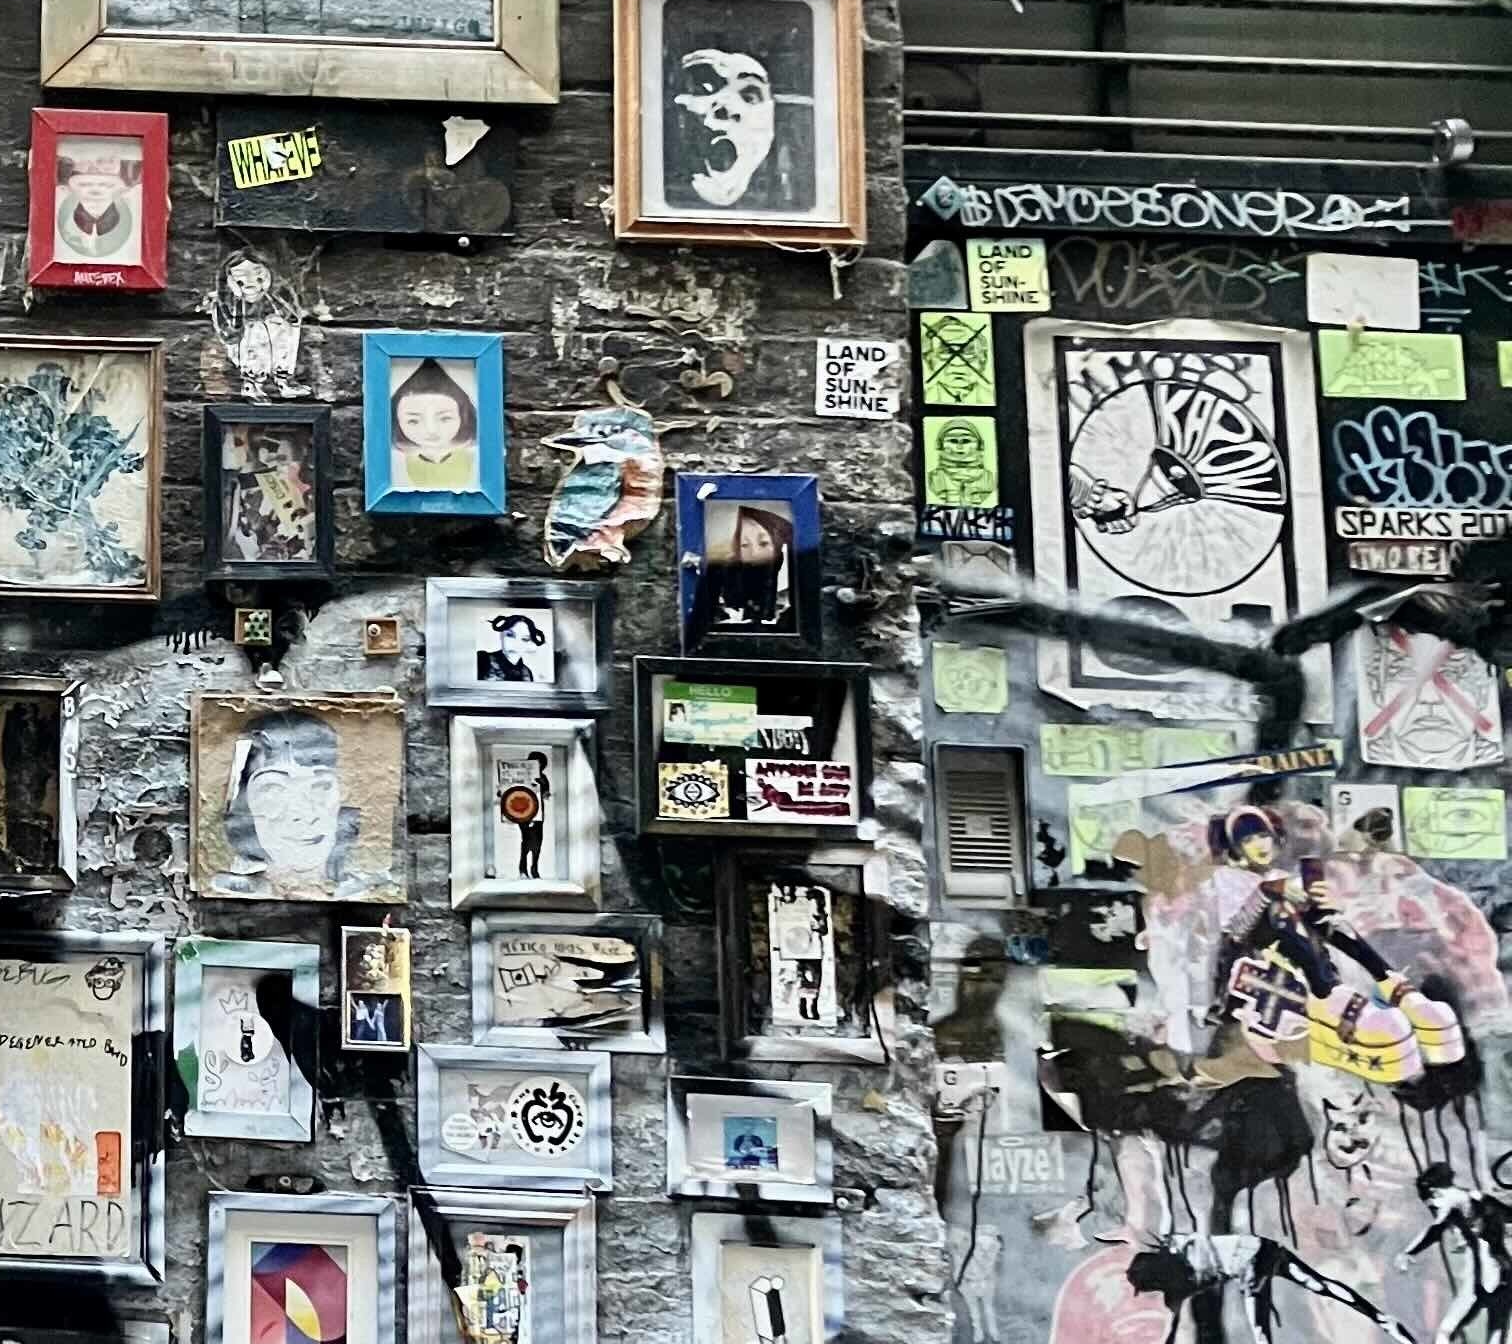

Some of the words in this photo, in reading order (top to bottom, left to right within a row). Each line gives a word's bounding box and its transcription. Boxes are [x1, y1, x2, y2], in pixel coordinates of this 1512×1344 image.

[976, 244, 1034, 260] LAND
[978, 260, 1007, 274] OF
[979, 275, 1027, 290] SUN-
[981, 289, 1040, 305] SHINE
[825, 344, 887, 362] LAND
[825, 362, 856, 376] OF
[825, 377, 877, 395] SUN-
[825, 394, 890, 414] SHINE
[1341, 510, 1453, 538] SPARKS
